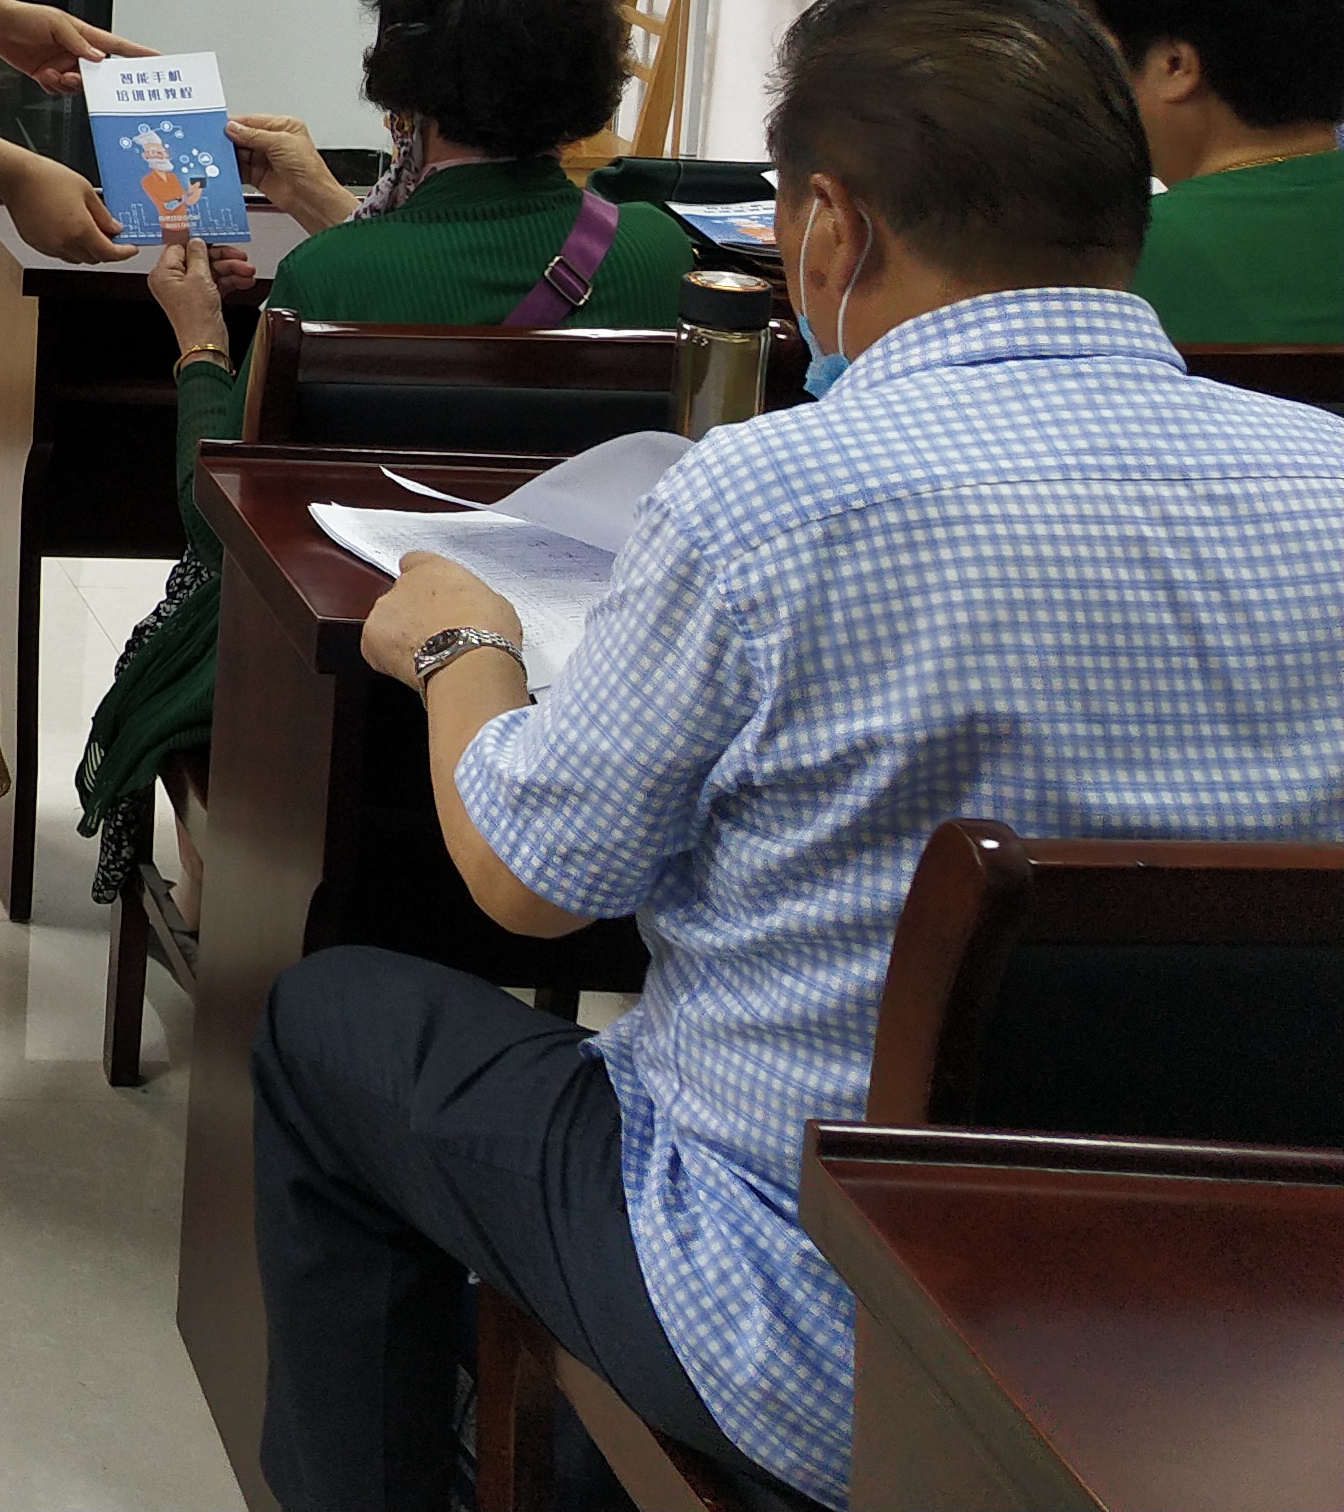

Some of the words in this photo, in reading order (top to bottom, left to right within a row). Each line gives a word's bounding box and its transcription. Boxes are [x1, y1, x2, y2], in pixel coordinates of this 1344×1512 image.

[119, 70, 182, 85] 智能手机
[116, 87, 193, 102] 培训班教程
